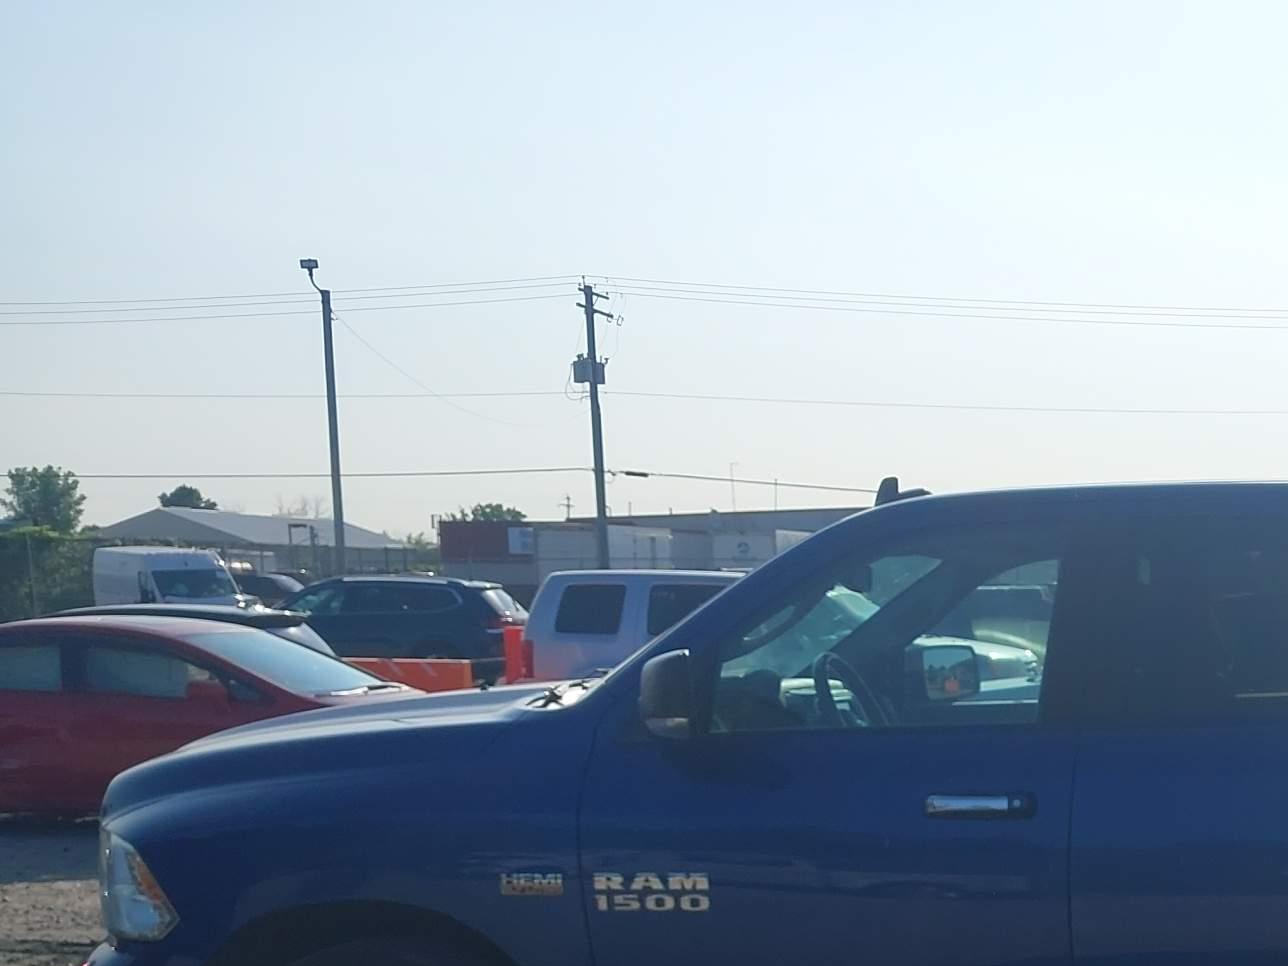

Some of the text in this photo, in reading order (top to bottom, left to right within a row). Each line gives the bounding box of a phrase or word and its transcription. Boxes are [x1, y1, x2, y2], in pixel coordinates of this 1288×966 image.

[500, 872, 563, 886] HEMI
[592, 872, 710, 891] RAM
[592, 894, 711, 911] 1500
